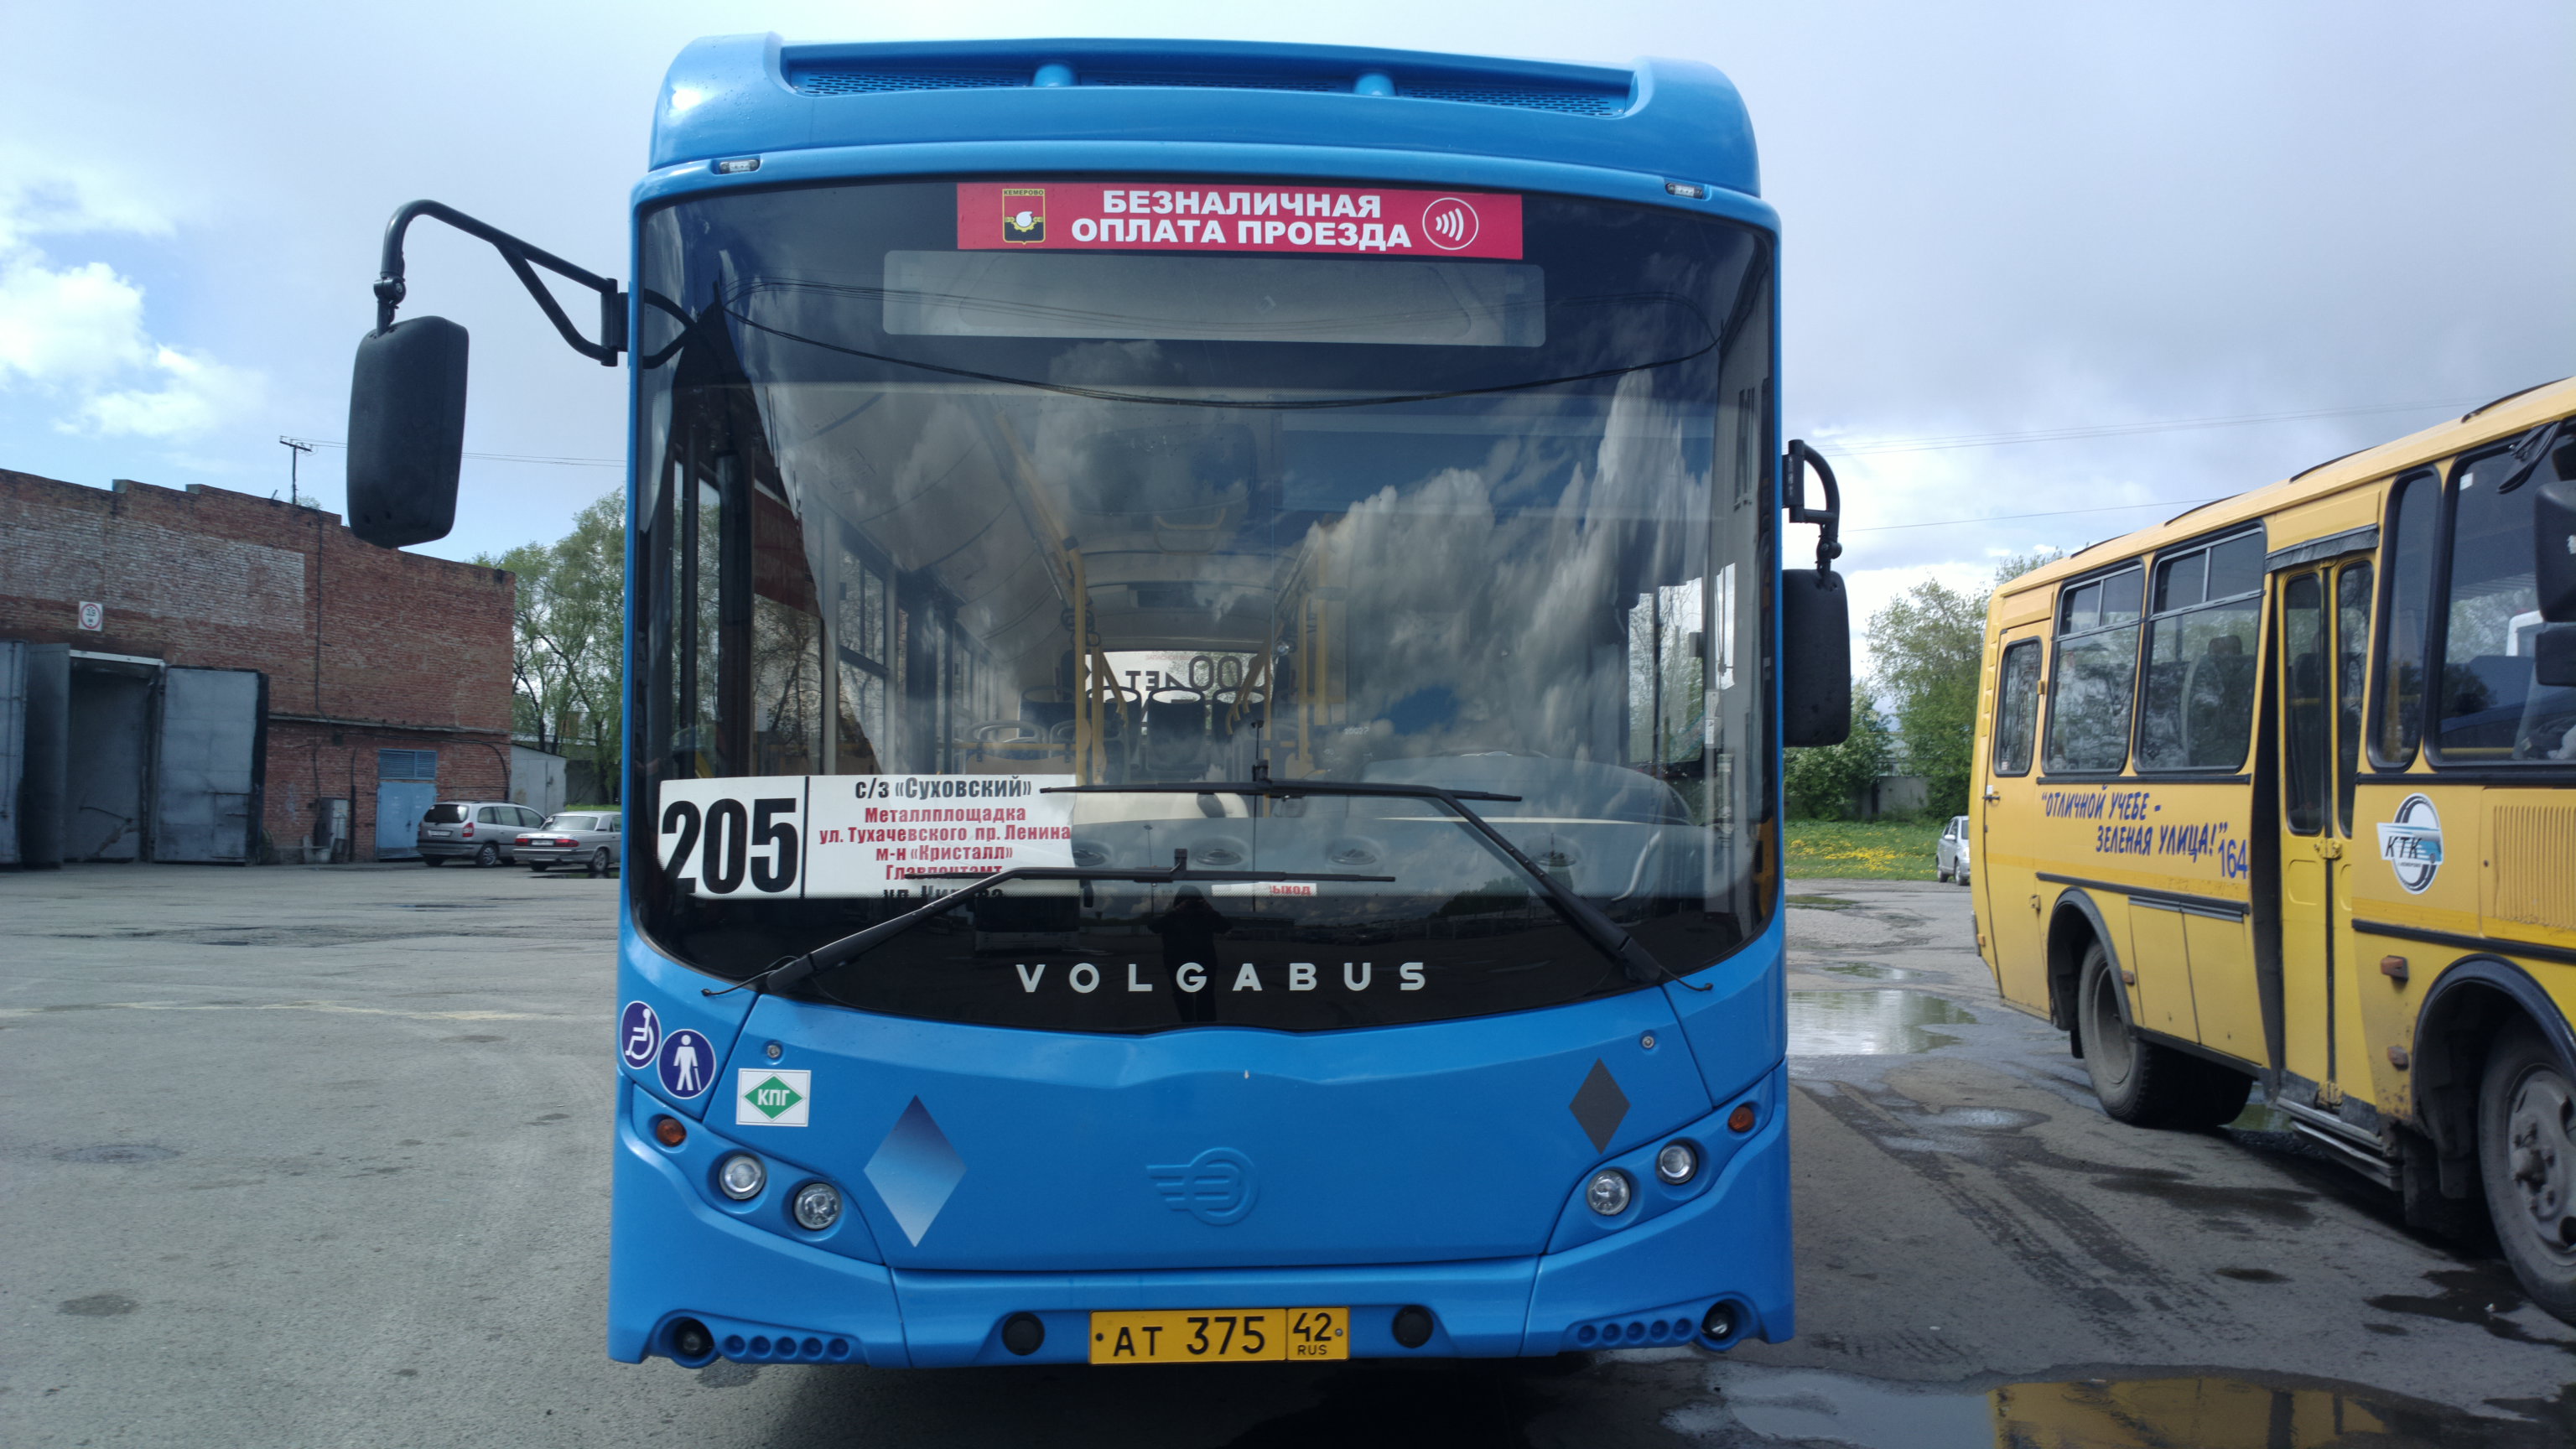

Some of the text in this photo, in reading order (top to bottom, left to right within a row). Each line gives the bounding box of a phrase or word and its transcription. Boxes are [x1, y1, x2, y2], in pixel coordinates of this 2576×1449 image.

[1103, 190, 1381, 218] БЕЗНАЛИЧНАЯ
[1071, 217, 1412, 252] ОПЛАТА ПРОЕЗДА
[855, 776, 1032, 800] с/з «Суховский»
[865, 808, 1026, 823] Металлплощадка
[2108, 791, 2150, 820] УЧЕБЕ
[661, 797, 798, 895] 205
[819, 824, 1072, 844] ул. Тухачевского пр. Ленина
[2096, 824, 2154, 856] ЗЕЛЕНАЯ
[2384, 835, 2423, 859] КТК
[875, 845, 1014, 862] м-н «Кристалл»
[2218, 839, 2248, 880] 164
[1270, 885, 1311, 896] ЫХОД
[1015, 961, 1426, 994] VOLGABUS
[757, 1088, 790, 1106] КПГ
[1113, 1316, 1266, 1357] АТ 375
[1292, 1311, 1332, 1343] 42
[1296, 1344, 1327, 1356] RUS
